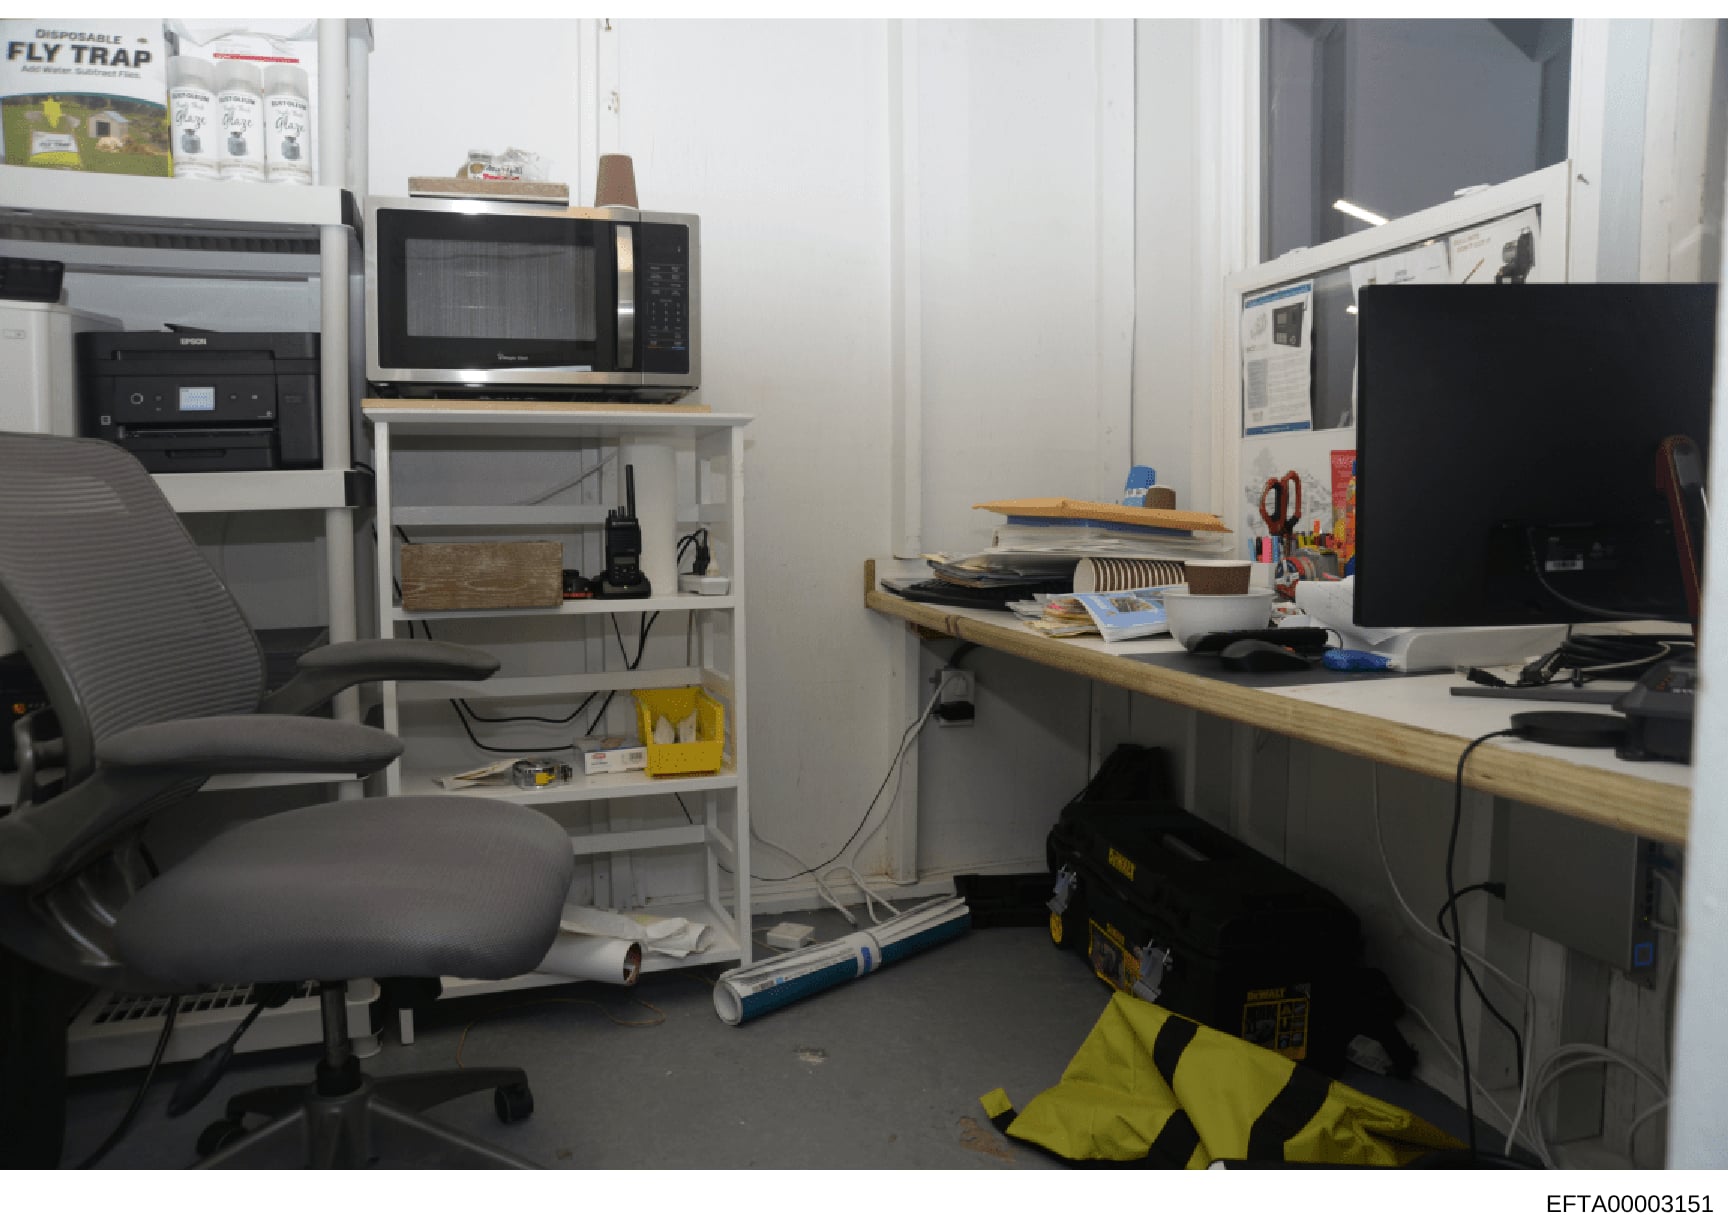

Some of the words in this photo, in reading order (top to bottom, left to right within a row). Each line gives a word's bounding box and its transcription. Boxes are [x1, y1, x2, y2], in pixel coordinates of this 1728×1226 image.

[35, 28, 123, 45] DISPOSABLE
[7, 41, 62, 62] FLY
[71, 44, 152, 68] TRAP
[21, 65, 41, 73] Add
[75, 67, 117, 77] Subtract
[179, 338, 207, 346] EPSON
